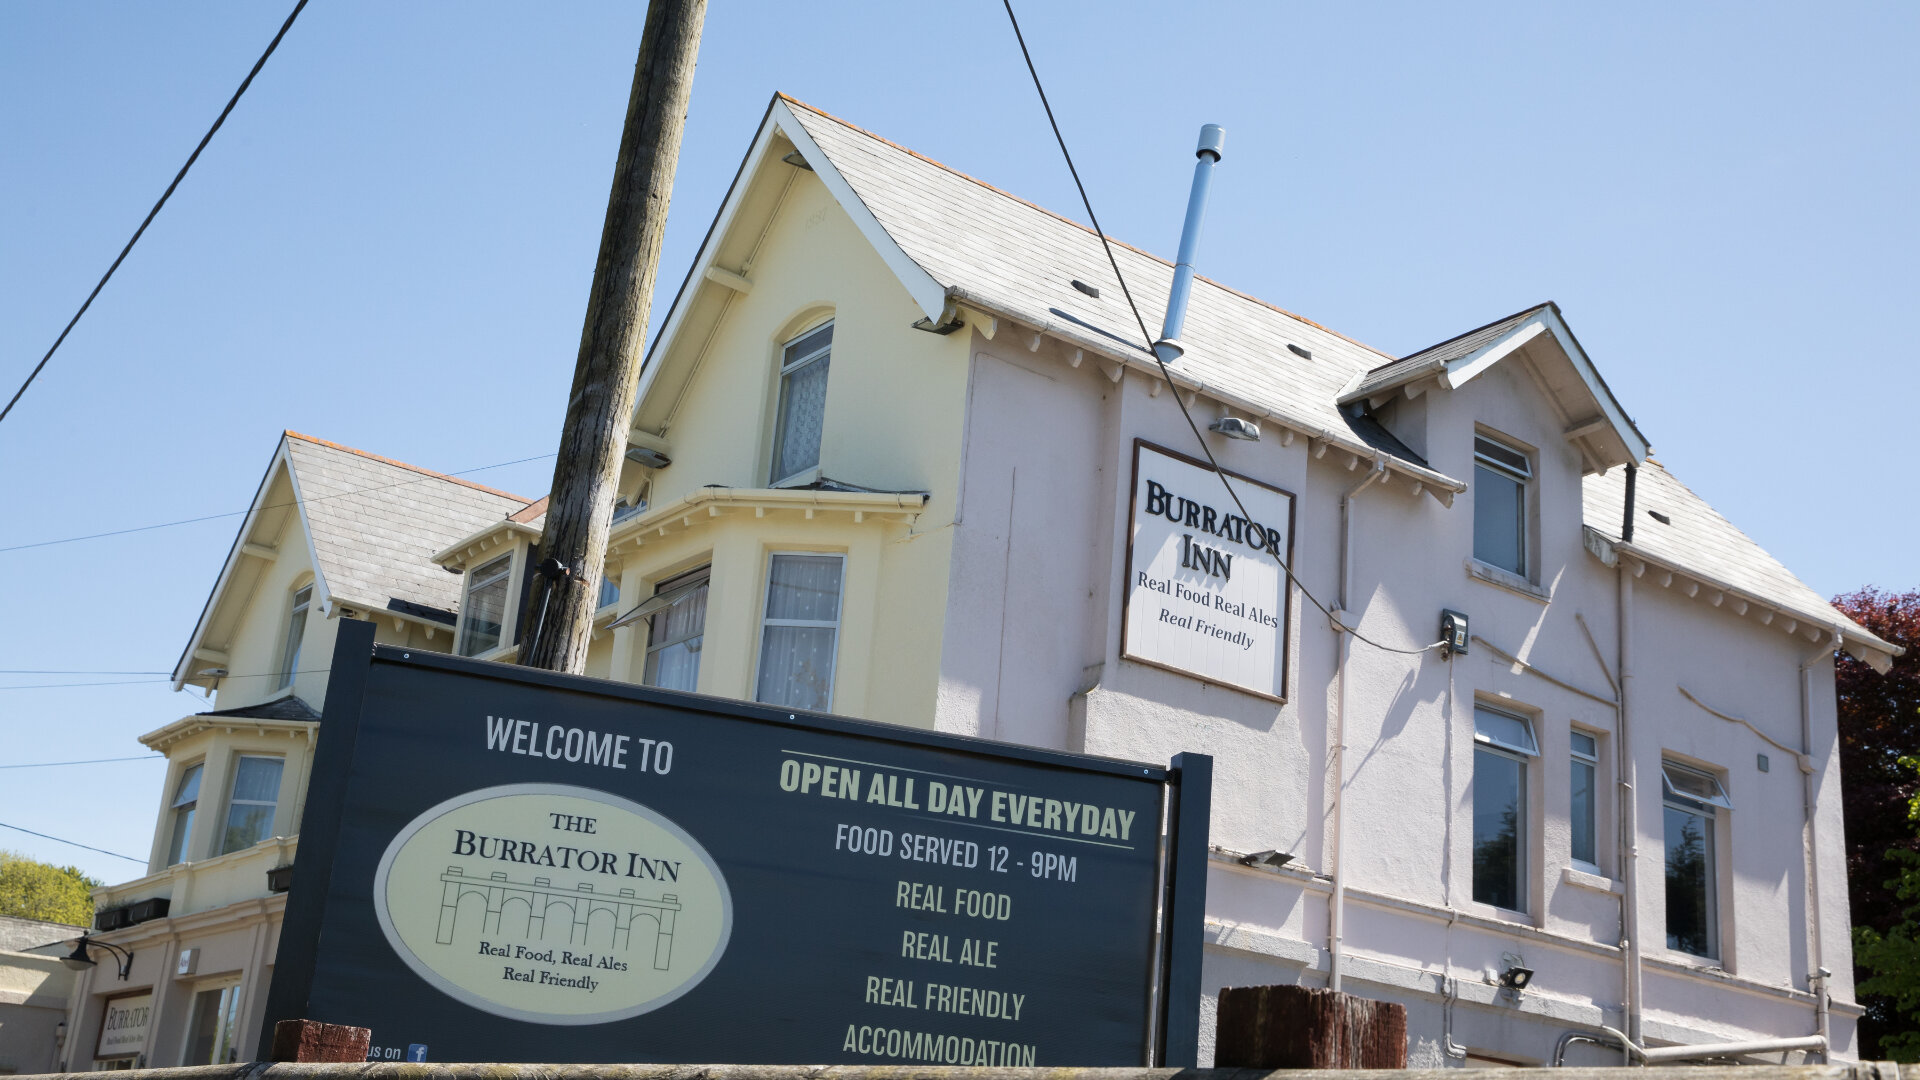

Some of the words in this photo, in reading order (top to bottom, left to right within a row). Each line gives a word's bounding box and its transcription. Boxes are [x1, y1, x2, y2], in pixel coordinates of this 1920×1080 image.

[1145, 480, 1281, 555] BURRATOR
[1181, 534, 1233, 582] INN
[1138, 570, 1171, 595] Real
[1175, 582, 1210, 607] Food
[1214, 594, 1245, 618] Real
[1248, 606, 1278, 629] Ales
[1159, 608, 1193, 630] Real
[1195, 619, 1254, 651] Friendly
[487, 716, 630, 770] WELCOME
[638, 737, 674, 776] TO
[780, 760, 860, 802] OPEN
[867, 773, 920, 810] ALL
[928, 782, 985, 819] DAY
[991, 791, 1136, 841] EVERYDAY
[549, 812, 597, 835] THE
[452, 829, 618, 875] BURRATOR
[625, 852, 682, 883] INN
[835, 824, 893, 857] FOOD
[900, 832, 979, 869] SERVED
[987, 845, 1010, 874] 12
[1031, 851, 1078, 883] 9PM
[895, 880, 947, 914] REAL
[954, 888, 1012, 921] FOOD
[478, 941, 511, 958] Real
[514, 945, 557, 966] Food,
[561, 951, 593, 968] Real
[596, 955, 628, 972] Ales
[901, 930, 953, 964] REAL
[959, 939, 999, 969] ALE
[502, 966, 535, 983] Real
[539, 970, 599, 993] Friendly
[865, 975, 917, 1009] REAL
[924, 983, 1026, 1021] FRIENDLY
[384, 1047, 401, 1060] on
[842, 1024, 1037, 1067] ACCOMMODATION
